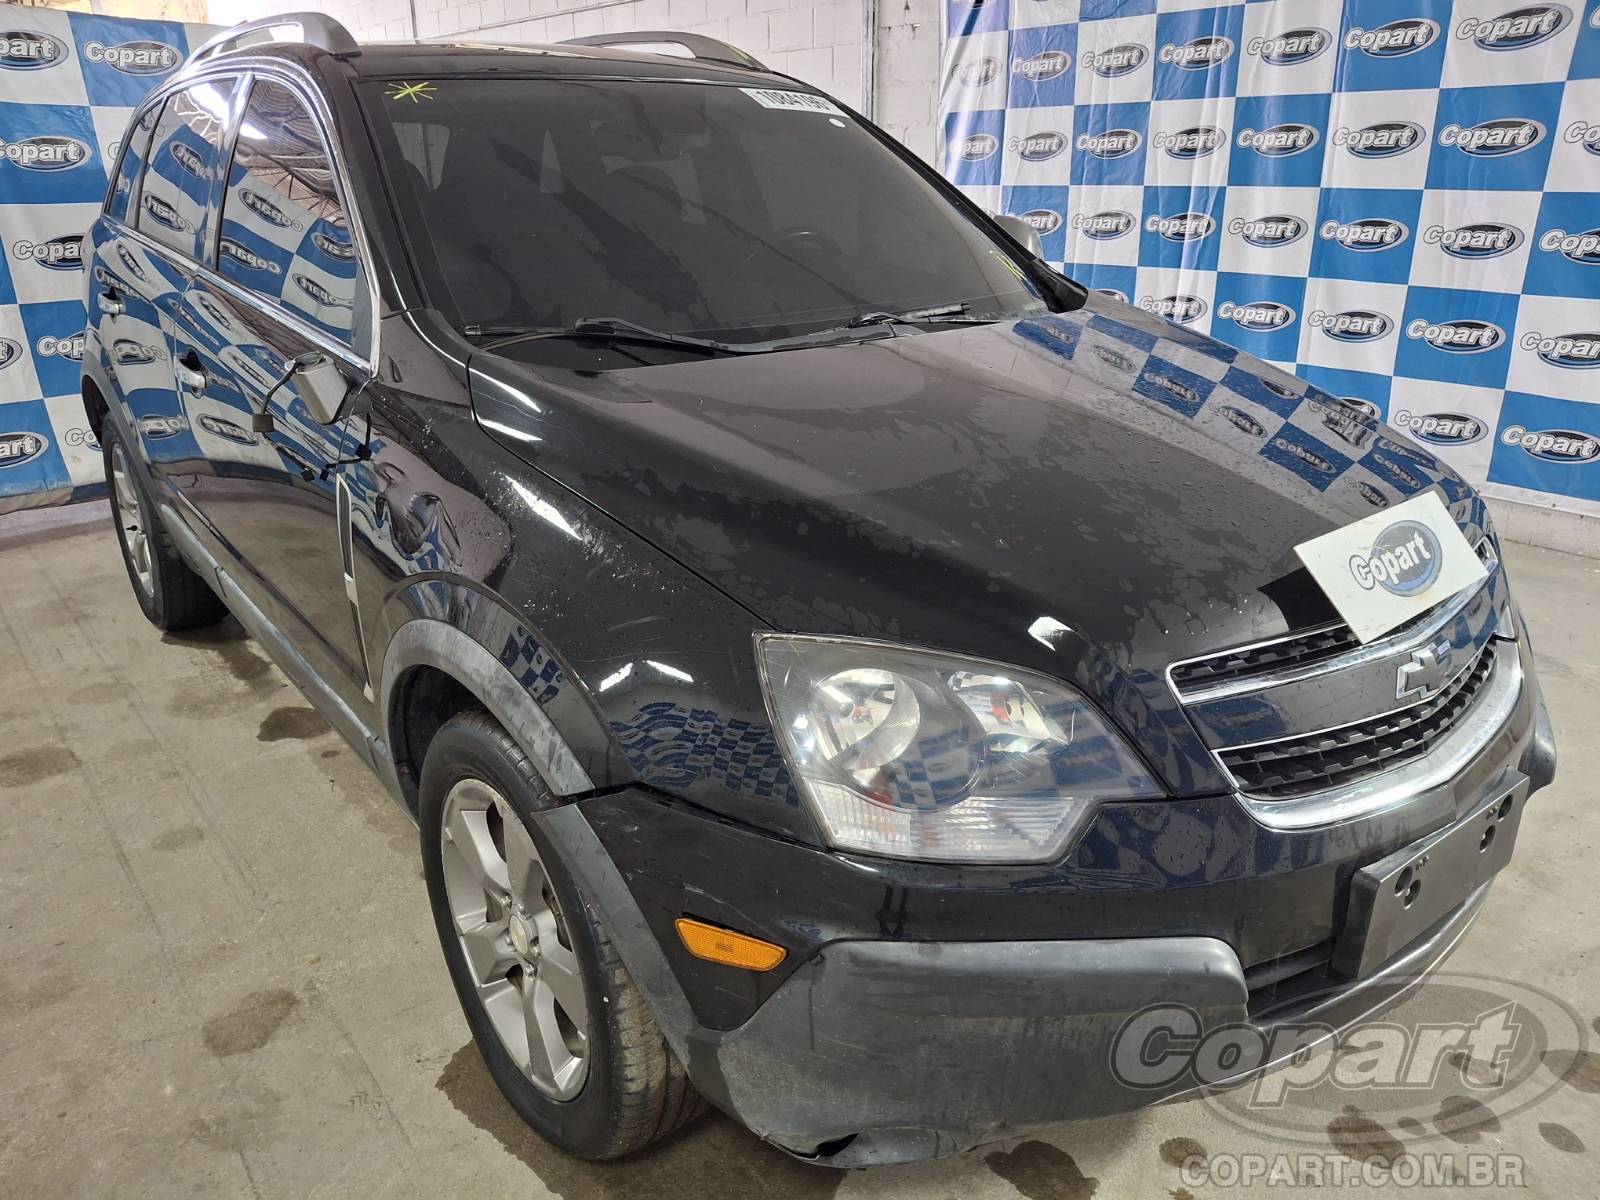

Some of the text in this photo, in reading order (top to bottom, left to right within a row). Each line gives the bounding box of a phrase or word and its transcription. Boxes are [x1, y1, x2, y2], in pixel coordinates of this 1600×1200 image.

[1344, 23, 1431, 51] Copart
[1456, 8, 1558, 44] Copart
[0, 38, 54, 59] art
[84, 41, 174, 68] Copart
[1158, 39, 1226, 66] Copart
[1247, 31, 1323, 57] Copart
[1012, 57, 1064, 78] Copart
[1081, 47, 1139, 71] Copart
[960, 139, 993, 157] part
[1008, 135, 1060, 154] Copart
[1077, 131, 1136, 155] Copart
[1153, 130, 1218, 155] Copart
[1237, 127, 1311, 150] Copart
[1333, 125, 1418, 150] Copart
[1439, 122, 1535, 151] Copart
[1072, 213, 1127, 231] Copart
[1145, 215, 1208, 238] Copart
[1228, 217, 1299, 240] Copart
[1320, 220, 1400, 245] Copart
[1423, 225, 1513, 252] Copart
[1539, 229, 1600, 258] Cop
[13, 240, 82, 263] Copa
[1140, 296, 1200, 317] Copart
[1217, 301, 1286, 326] Copart
[1308, 311, 1385, 334] Copart
[1406, 319, 1495, 346] Copart
[38, 336, 83, 358] Cop
[1521, 332, 1600, 359] Copar
[1395, 410, 1477, 438] Copart
[0, 434, 36, 458] art
[1501, 425, 1600, 457] Copart
[1349, 531, 1431, 590] Copart
